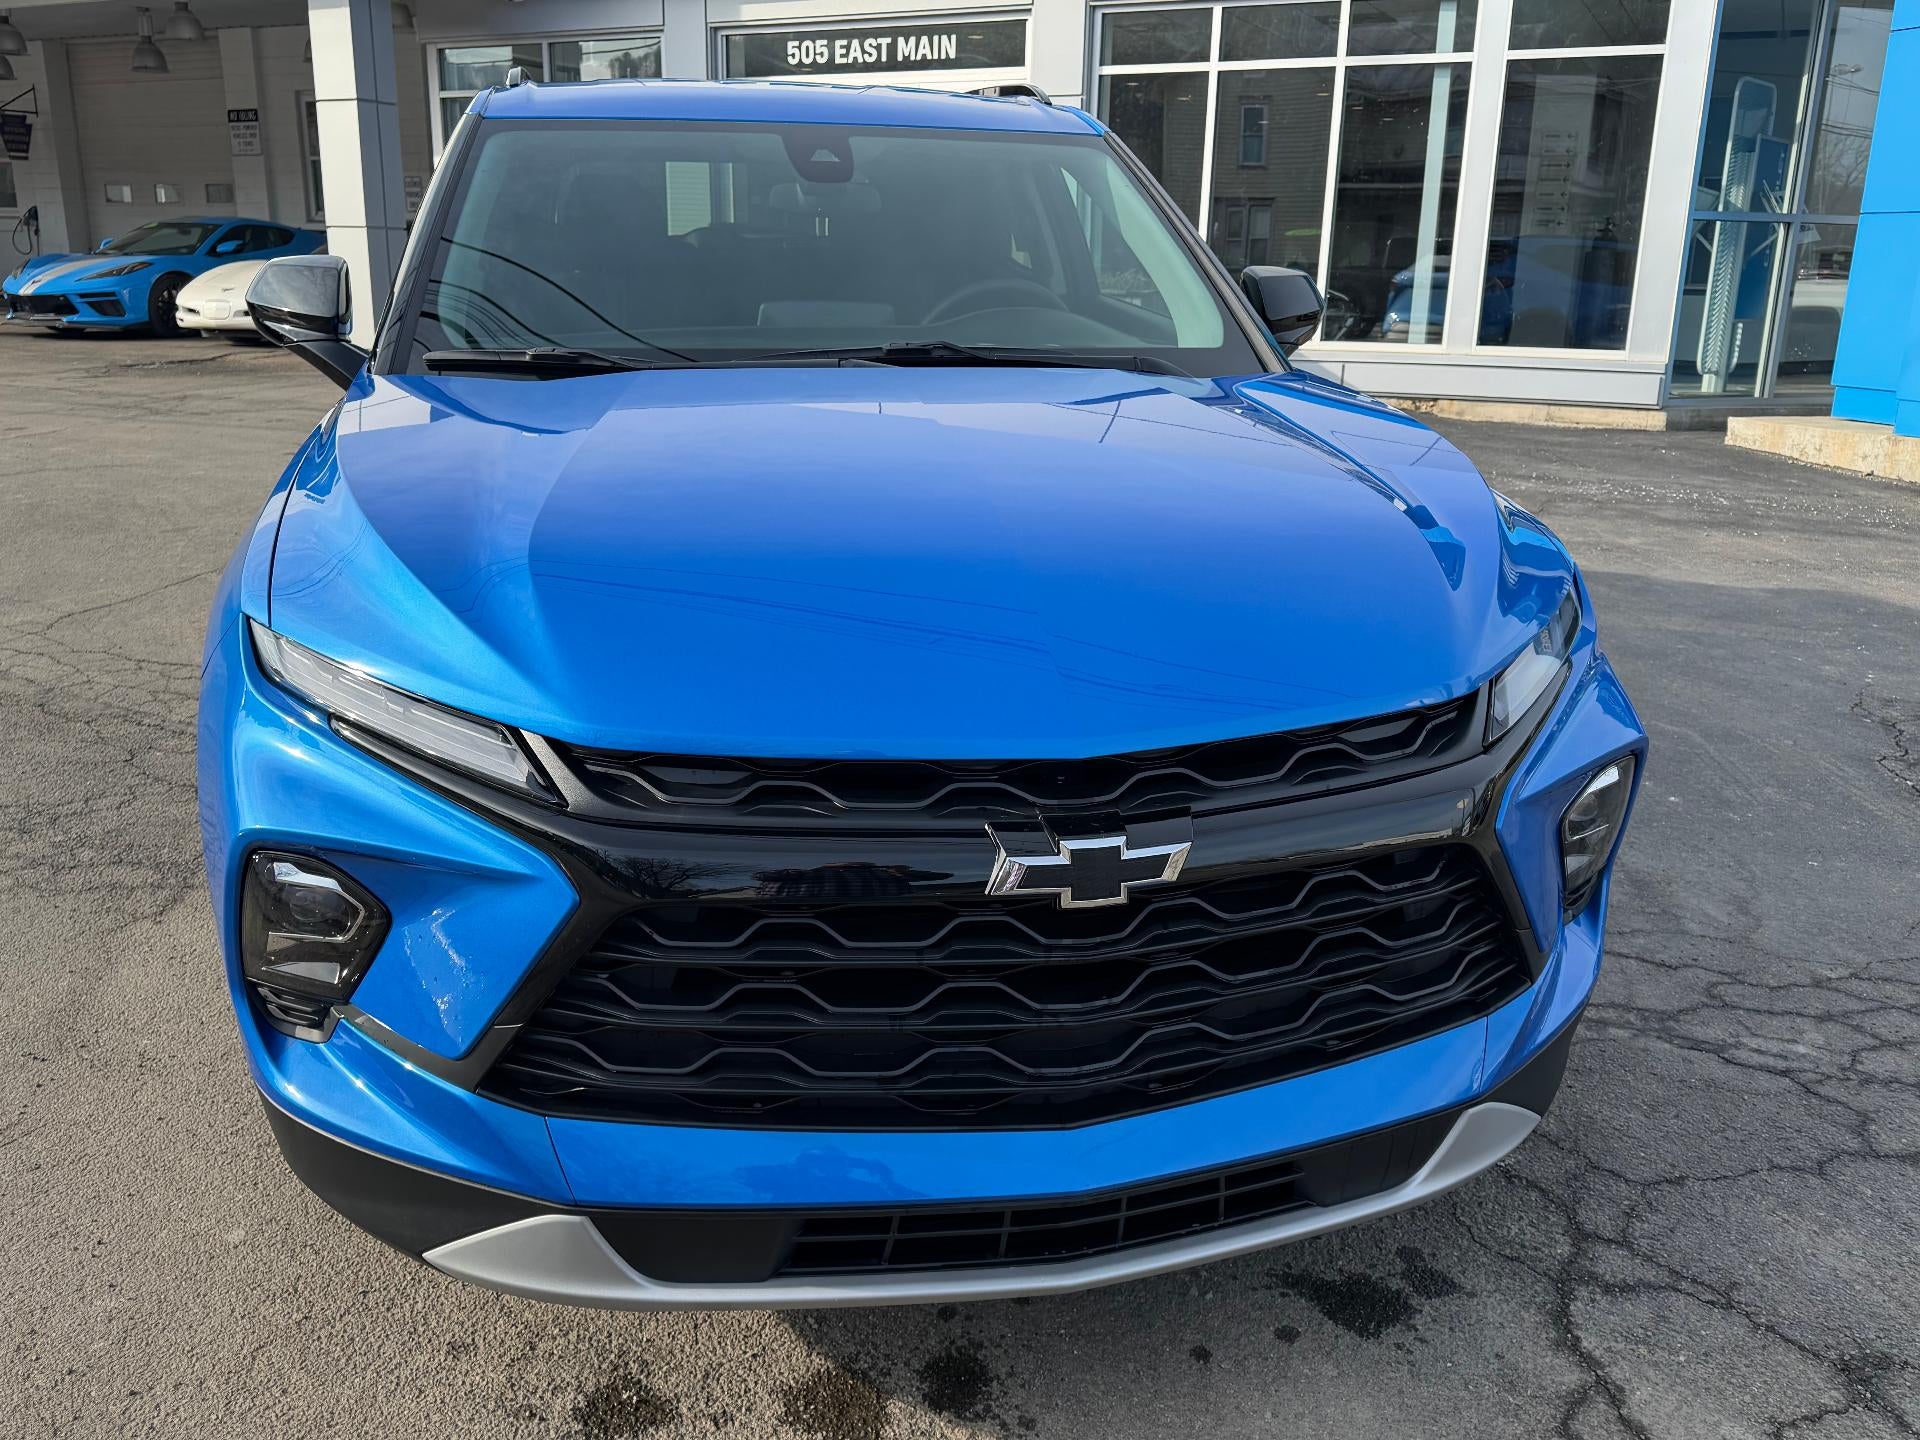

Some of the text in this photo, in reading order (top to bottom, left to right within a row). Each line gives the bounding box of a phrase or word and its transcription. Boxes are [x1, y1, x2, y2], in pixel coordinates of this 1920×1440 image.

[787, 34, 957, 65] 505 EAST MAIN
